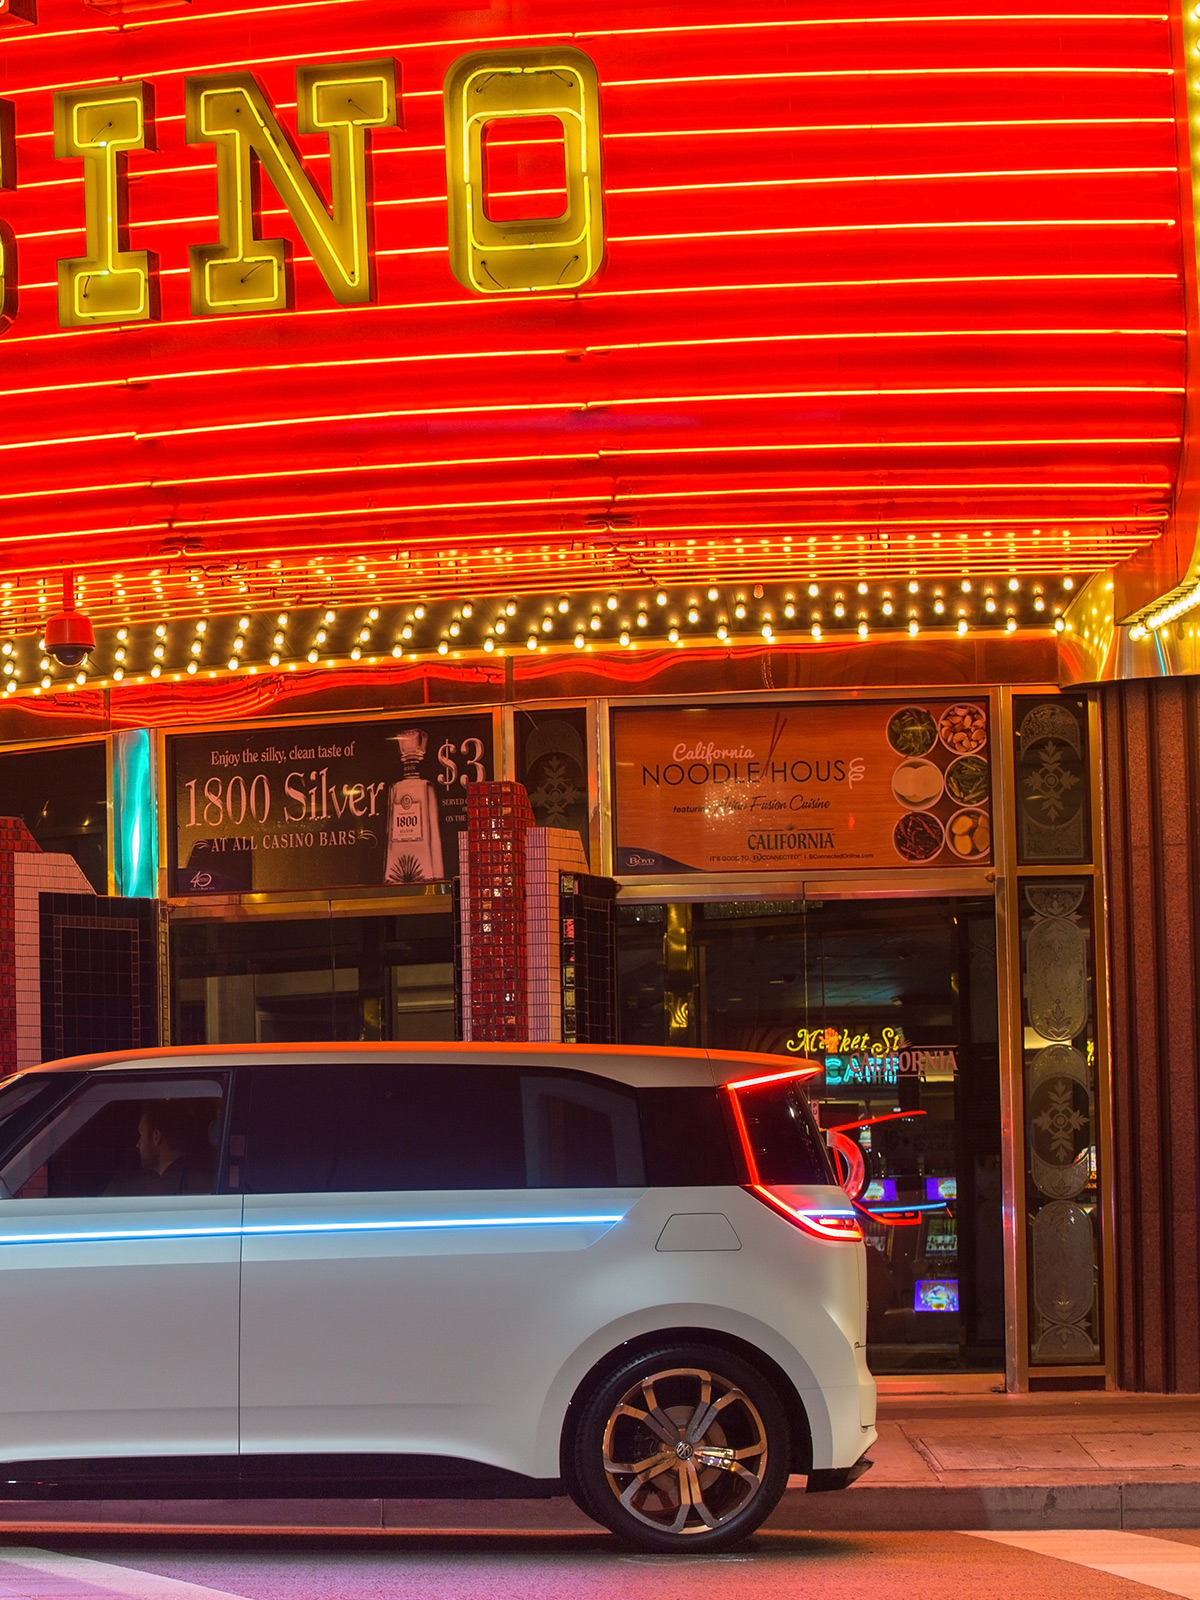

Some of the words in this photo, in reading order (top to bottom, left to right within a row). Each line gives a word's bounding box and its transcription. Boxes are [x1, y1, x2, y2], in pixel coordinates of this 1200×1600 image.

[211, 750, 240, 767] Enjoy
[242, 748, 259, 763] the
[261, 747, 287, 764] silky,
[289, 745, 315, 760] clean
[318, 744, 342, 758] taste
[344, 741, 356, 756] of
[437, 738, 486, 791] $3
[673, 741, 755, 765] California
[642, 762, 761, 786] NOODLE
[185, 774, 271, 828] 1800
[284, 767, 385, 822] Silver
[750, 796, 787, 811] Fusion
[789, 795, 830, 811] Cuisine
[397, 815, 418, 828] 1800
[211, 838, 228, 852] AT
[233, 837, 258, 851] ALL
[262, 833, 314, 850] CASINO
[320, 830, 356, 846] BARS
[748, 833, 832, 850] CALIFORNIA
[850, 1050, 958, 1073] CALIFORNIA
